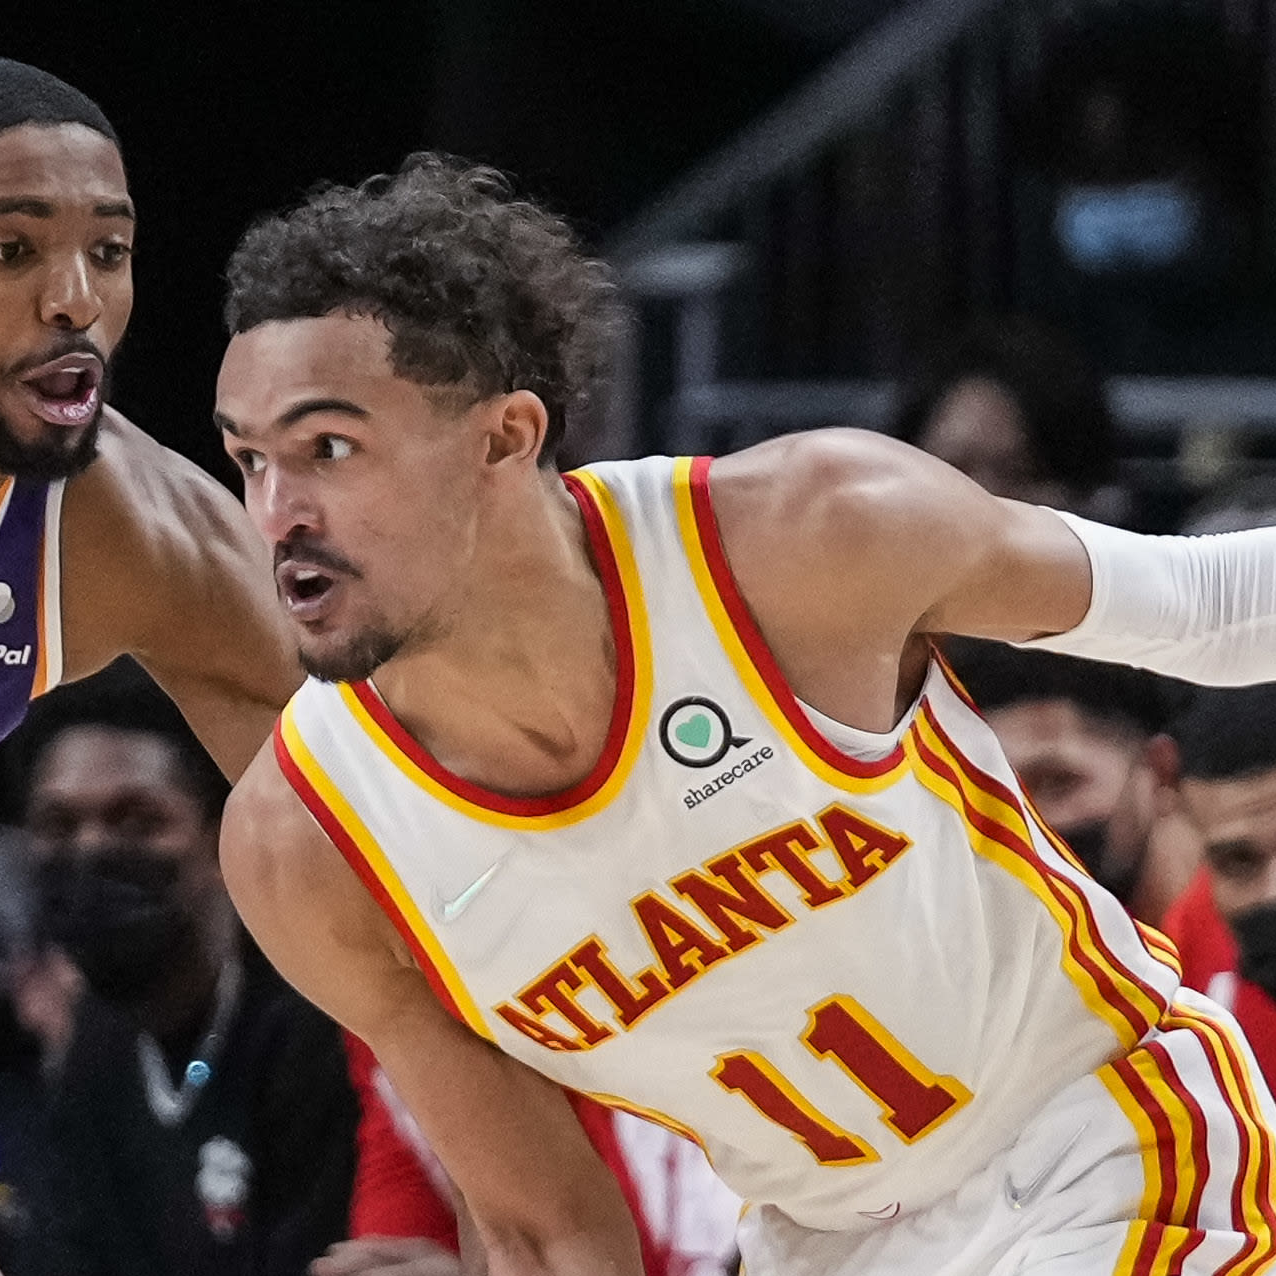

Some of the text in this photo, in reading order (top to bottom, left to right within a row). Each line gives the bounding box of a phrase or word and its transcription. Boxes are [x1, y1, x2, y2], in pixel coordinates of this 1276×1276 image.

[683, 746, 774, 810] sharecare
[493, 801, 915, 1053] ATLANTA
[707, 993, 974, 1167] 11
